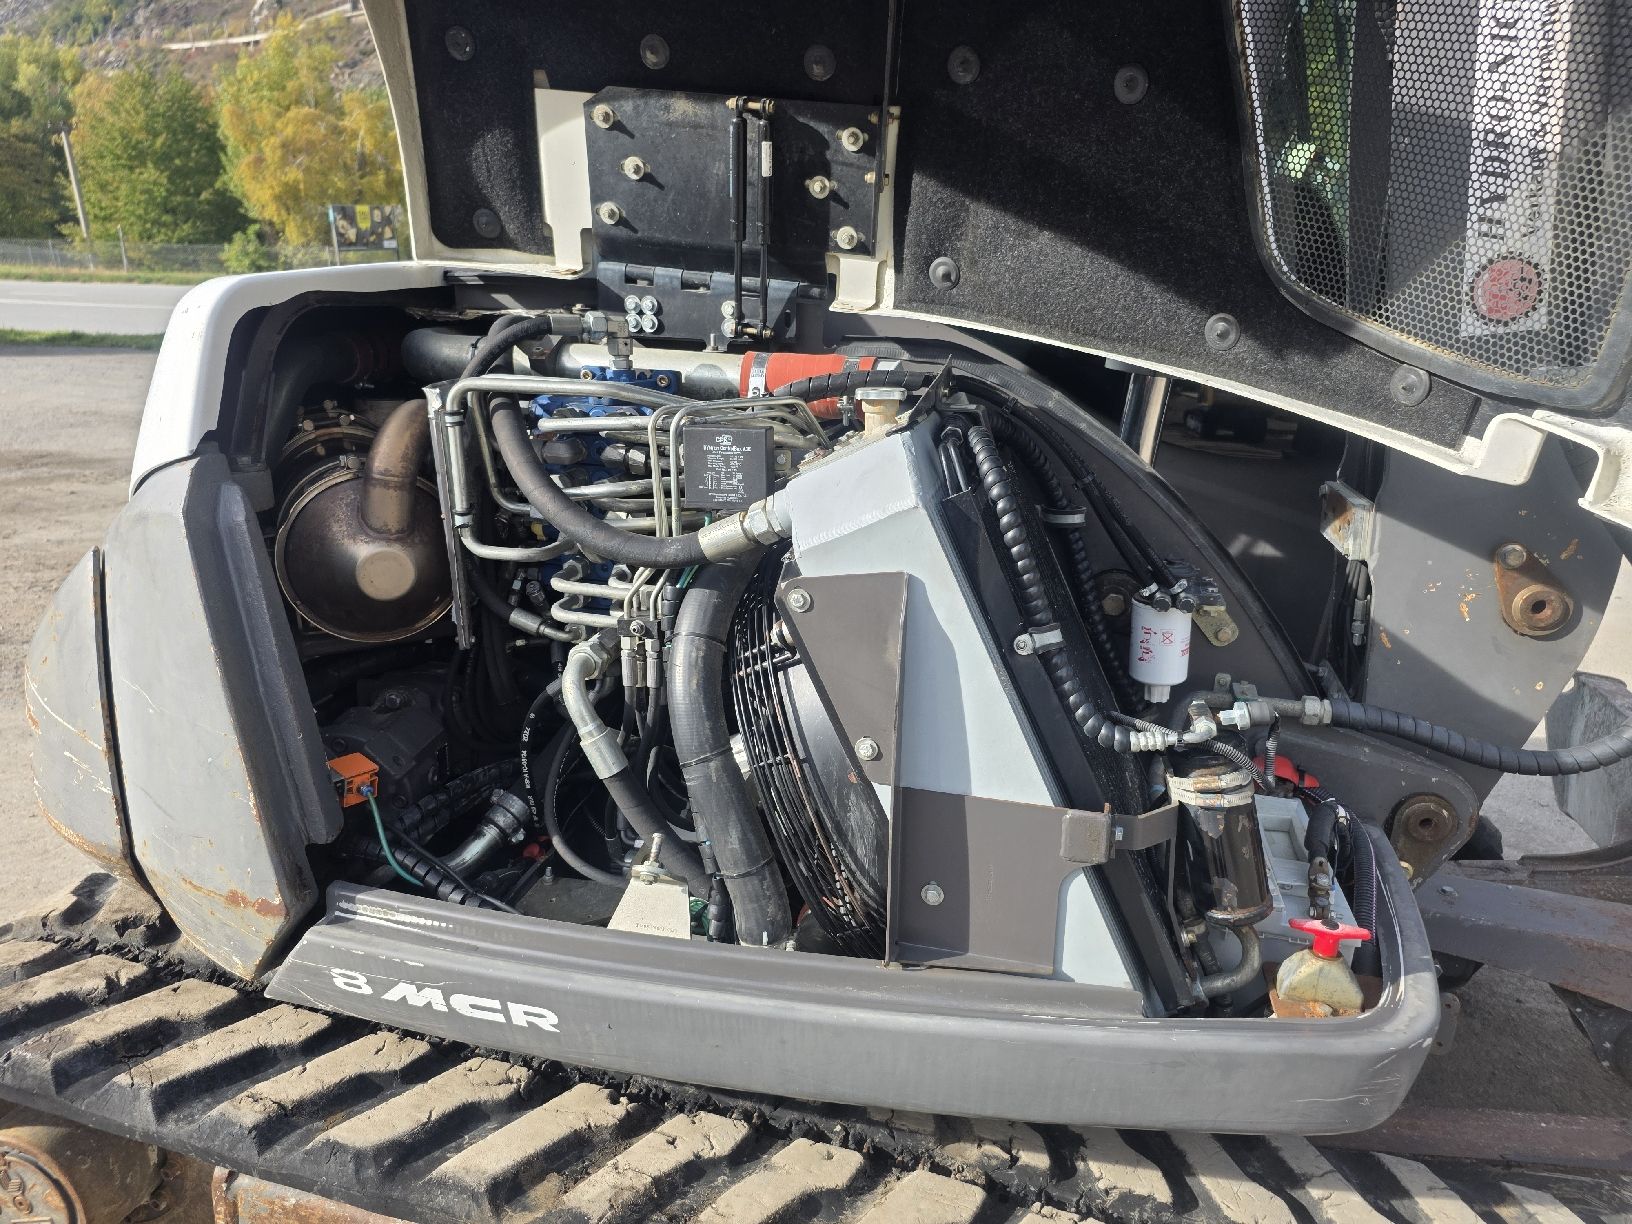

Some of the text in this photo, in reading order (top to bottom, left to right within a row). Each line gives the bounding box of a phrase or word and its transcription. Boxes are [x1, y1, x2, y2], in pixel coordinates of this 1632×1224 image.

[1529, 0, 1559, 115] Vermietu
[1478, 0, 1519, 241] HYDRO-NIC
[330, 968, 560, 1033] 8 MCR
